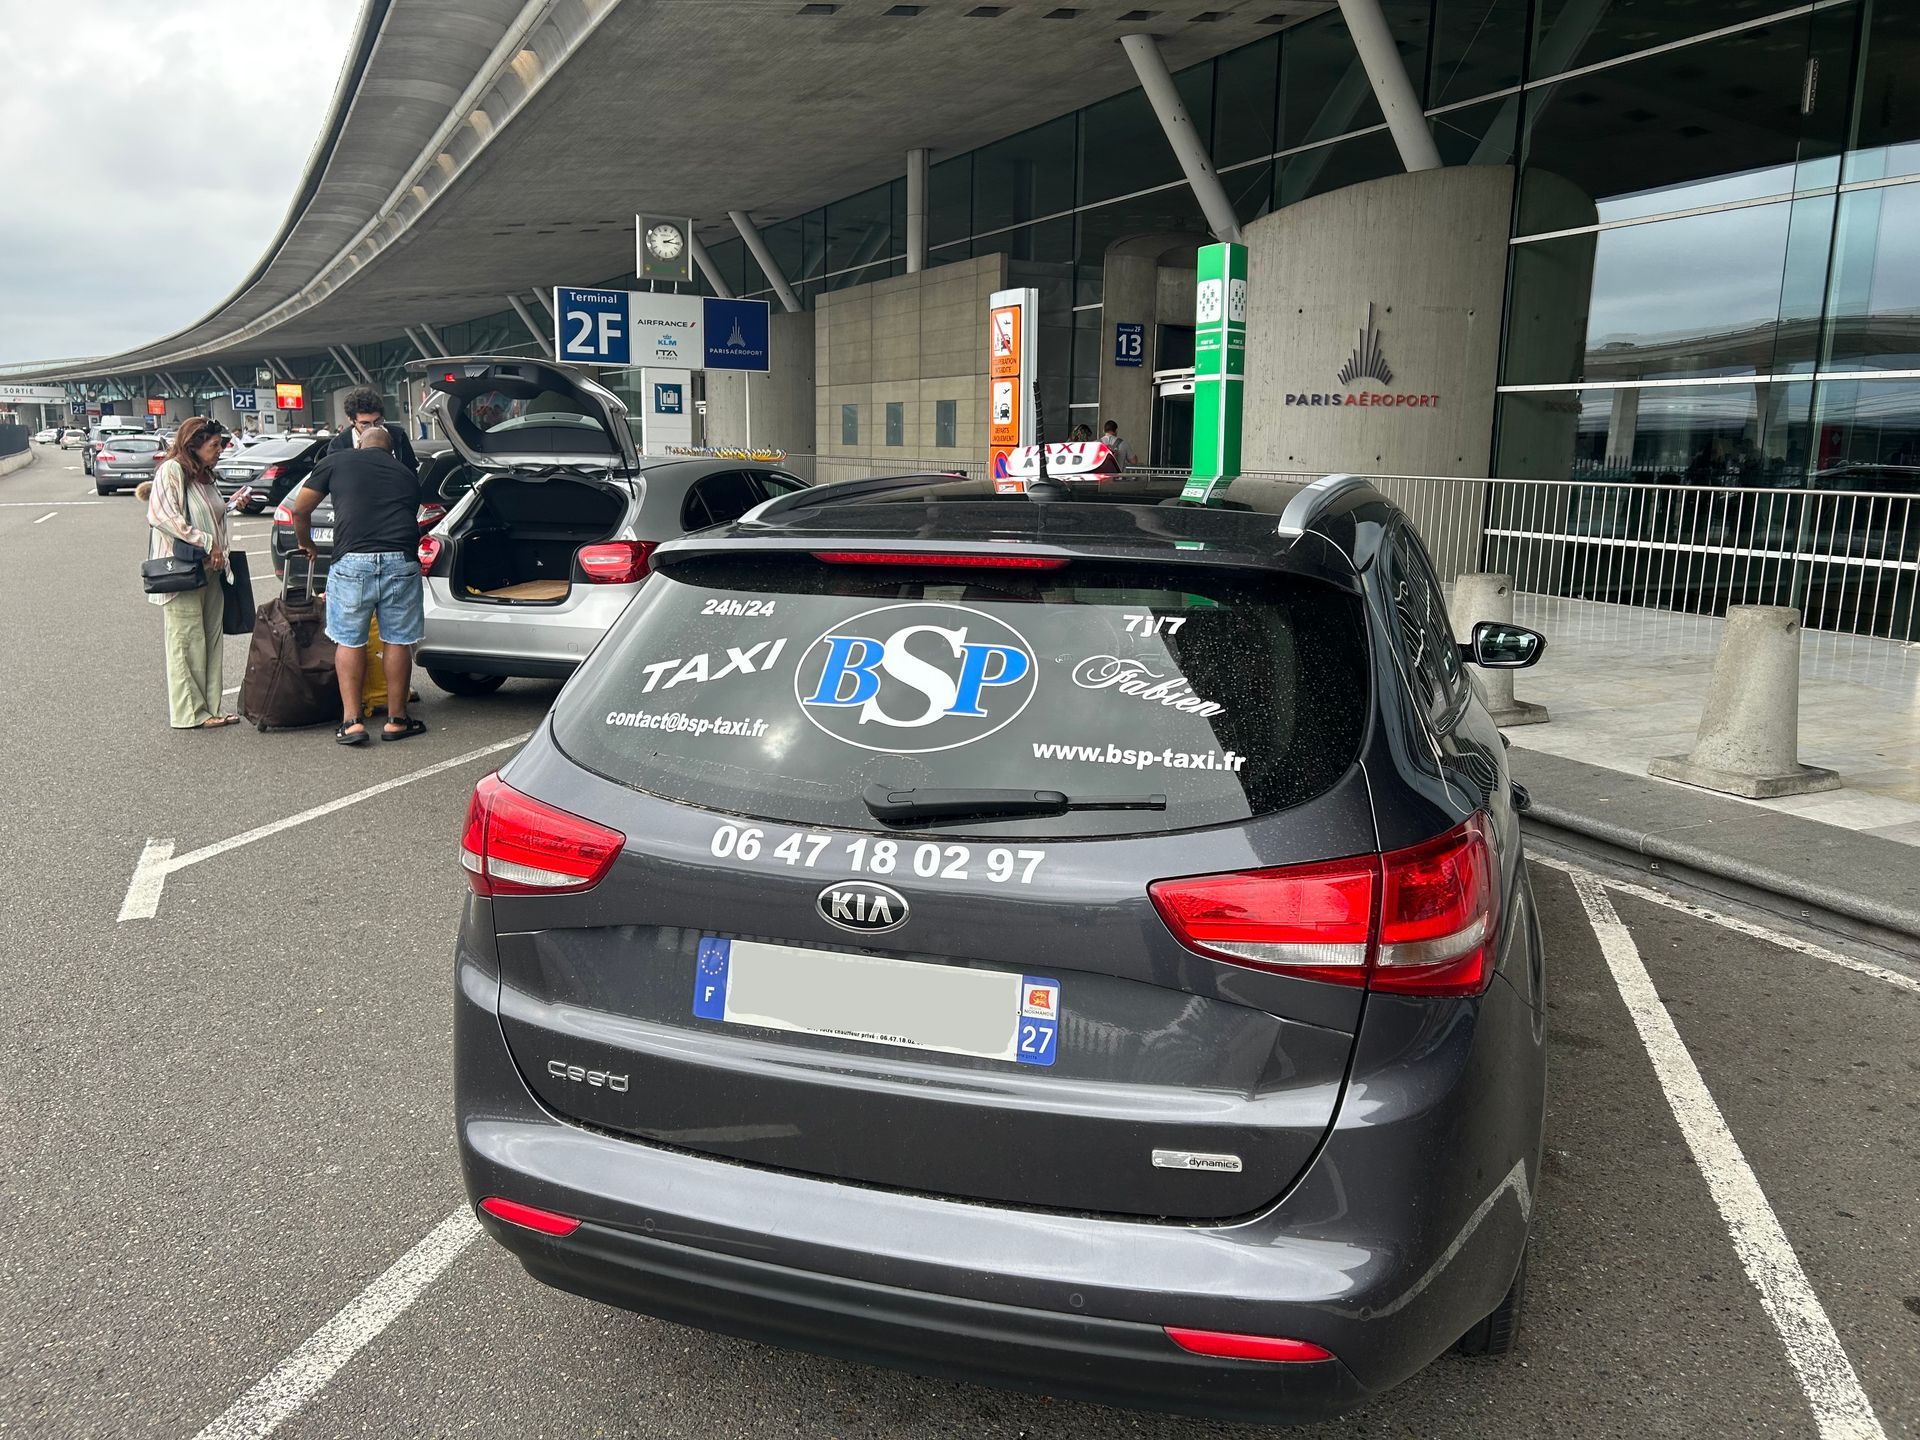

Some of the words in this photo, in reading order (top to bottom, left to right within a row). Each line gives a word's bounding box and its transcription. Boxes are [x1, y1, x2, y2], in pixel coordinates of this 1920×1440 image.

[570, 292, 617, 304] Terminal
[567, 311, 621, 355] 2F
[1118, 334, 1142, 355] 13
[4, 387, 34, 395] SORTIE
[235, 394, 254, 408] 2F
[73, 405, 84, 414] 2F
[701, 599, 776, 617] 24h/24
[1123, 614, 1187, 637] 7j/7
[641, 637, 788, 694] TAXI
[803, 625, 1030, 728] BSP
[1072, 654, 1226, 717] Fabien
[605, 711, 769, 737] contact@bsp-taxi.fr
[1032, 743, 1247, 772] www.bsp-taxi.fr
[710, 825, 764, 861] 06
[773, 832, 832, 867] 47
[845, 838, 898, 874] 18
[913, 844, 971, 880] 02
[986, 848, 1046, 884] 97
[831, 891, 893, 923] KIA
[704, 986, 715, 1002] F
[1021, 1025, 1053, 1054] 27
[1189, 1158, 1239, 1169] dynamics
